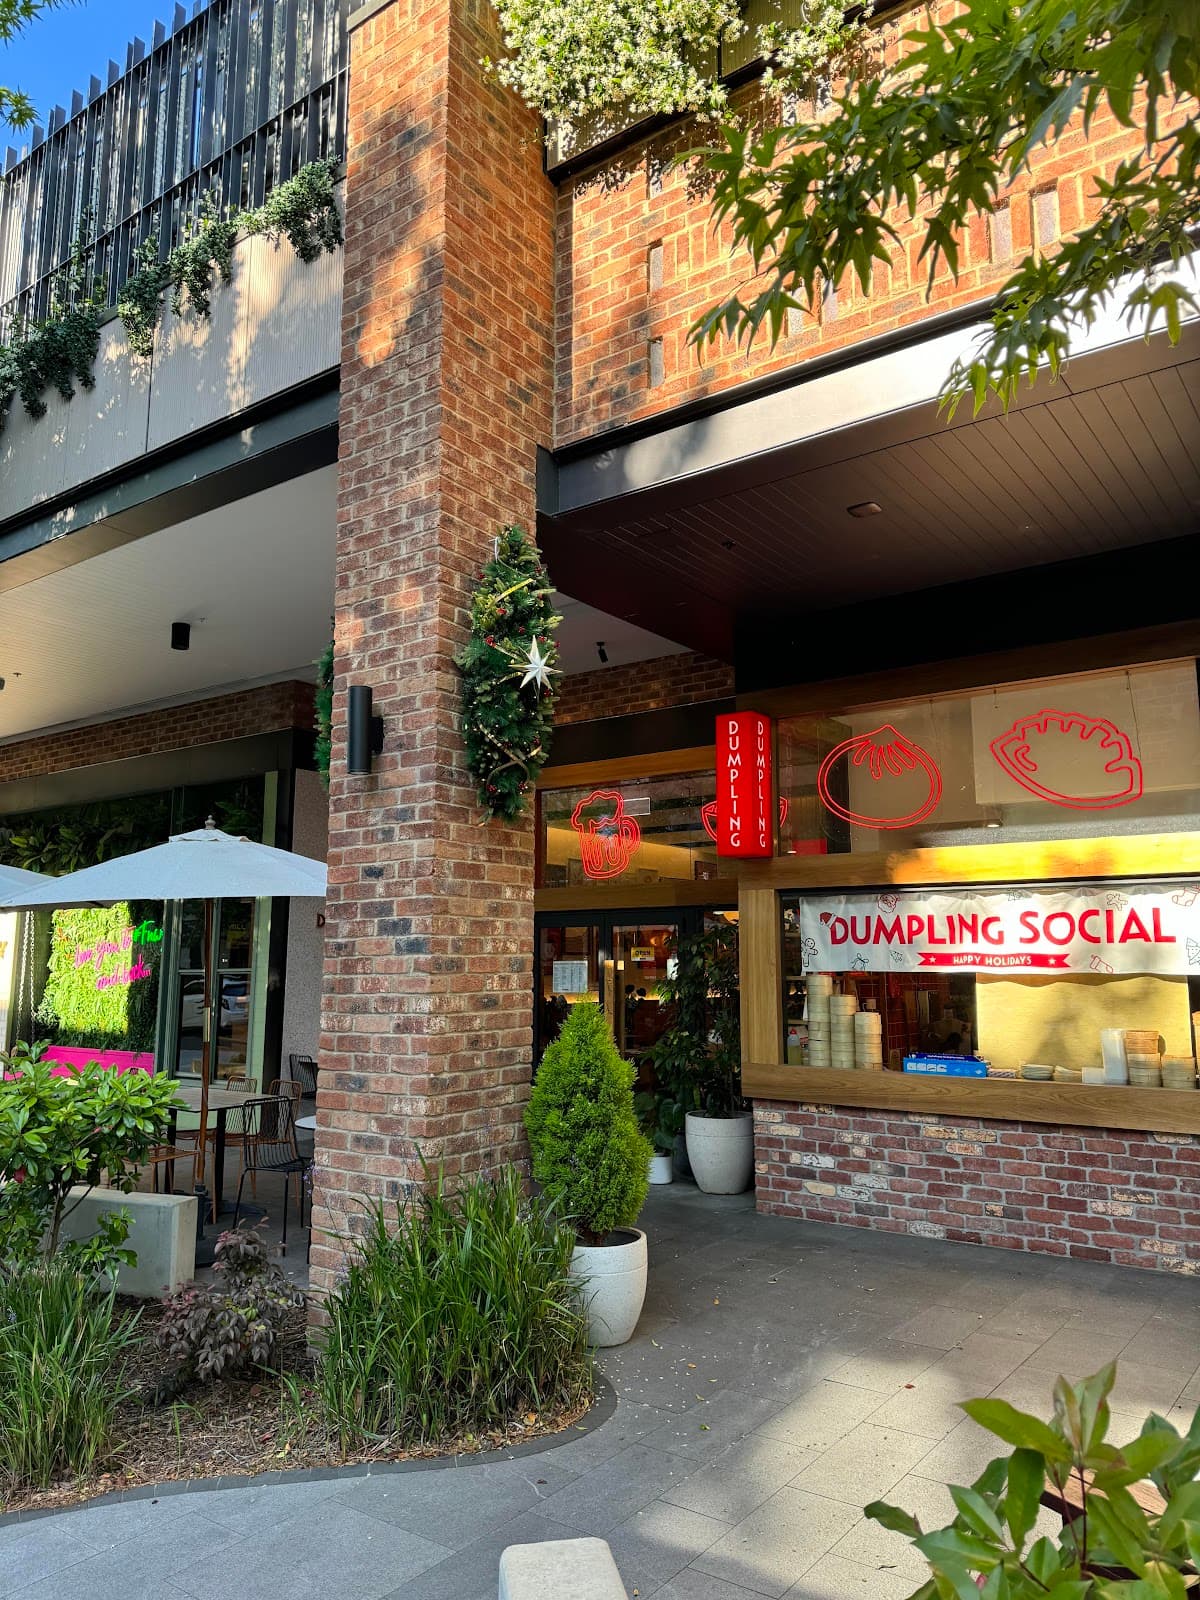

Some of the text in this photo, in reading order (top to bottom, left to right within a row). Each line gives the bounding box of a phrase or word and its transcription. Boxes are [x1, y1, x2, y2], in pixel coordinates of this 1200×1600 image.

[728, 720, 742, 847] DUMPLING
[756, 720, 766, 848] DUMPLING
[829, 907, 1177, 946] DUMPLING SOCIAL
[953, 955, 1032, 966] HAPPY HOLIDAYS
